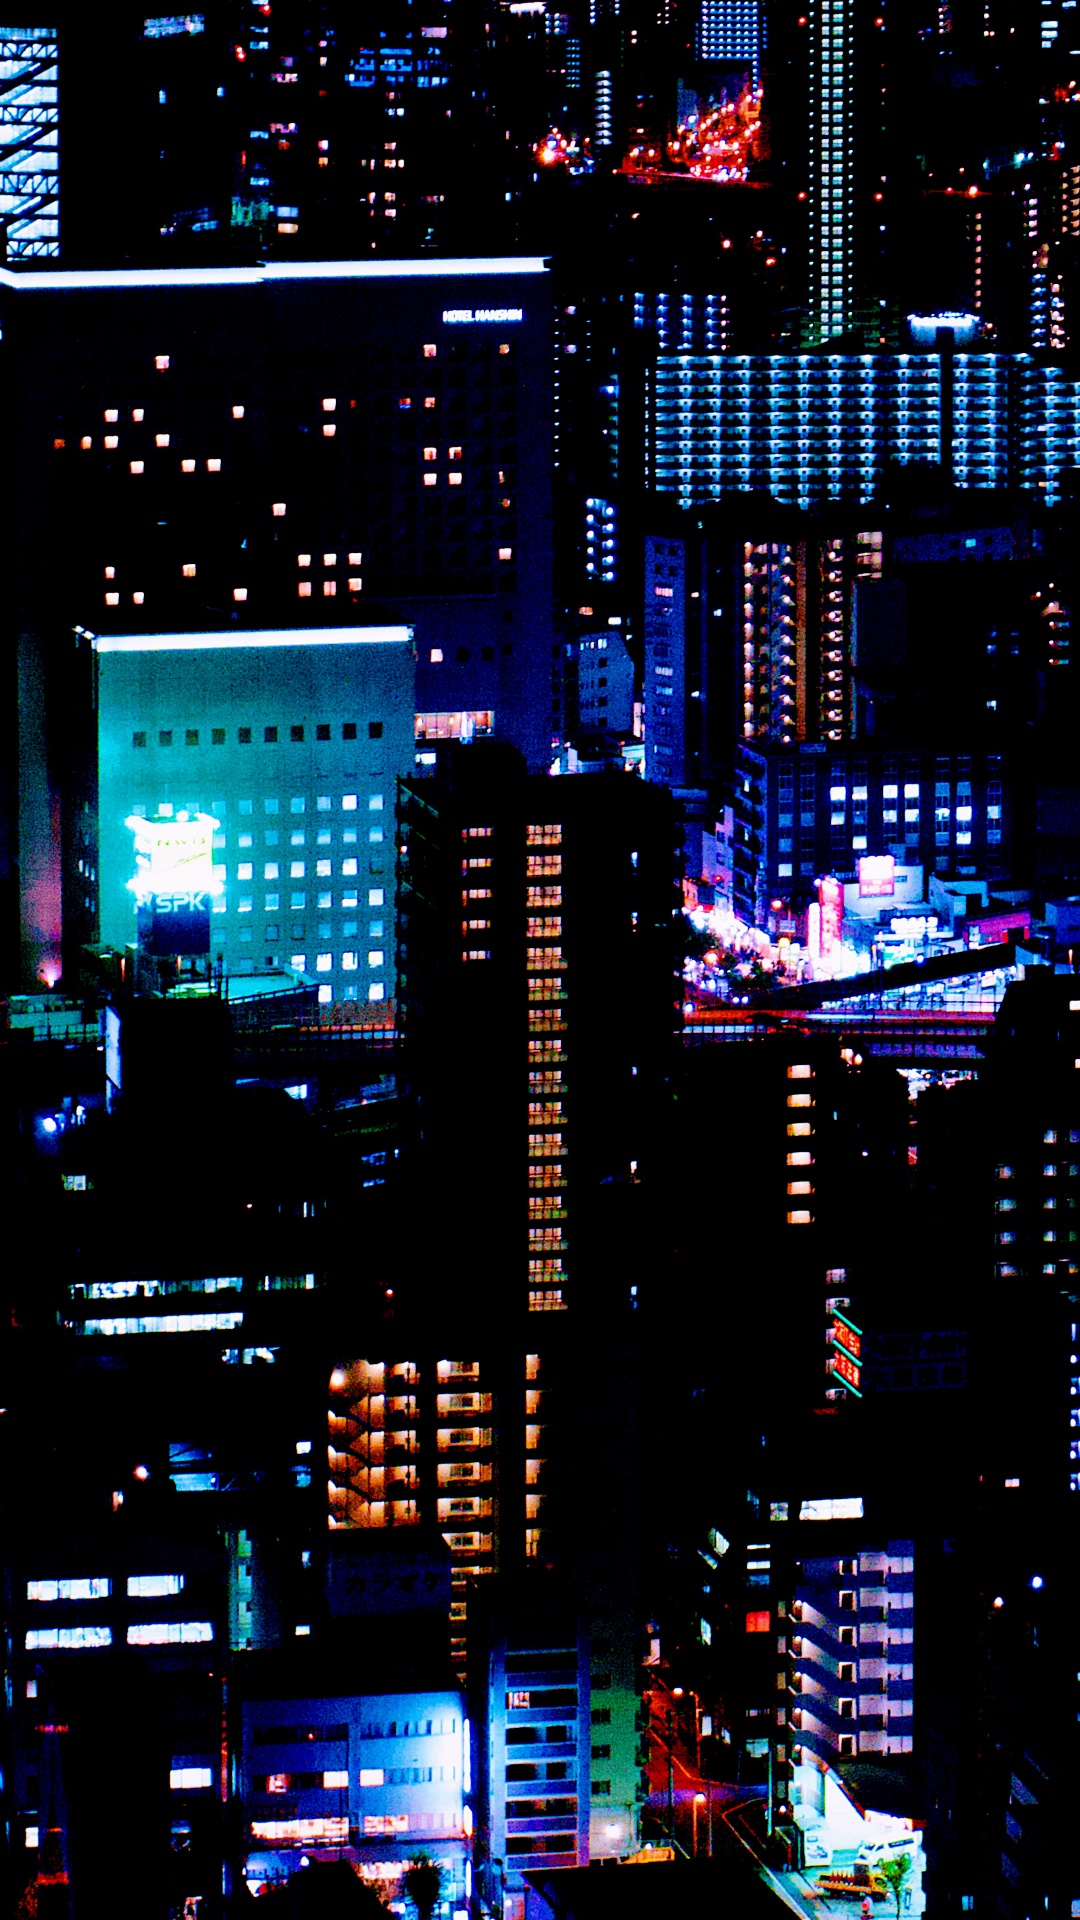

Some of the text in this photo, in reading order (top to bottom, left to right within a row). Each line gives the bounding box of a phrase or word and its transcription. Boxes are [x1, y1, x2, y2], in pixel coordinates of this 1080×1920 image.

[442, 308, 523, 322] HOTEL HANSHIN
[155, 891, 206, 913] SPK
[345, 1571, 444, 1596] カラオケ
